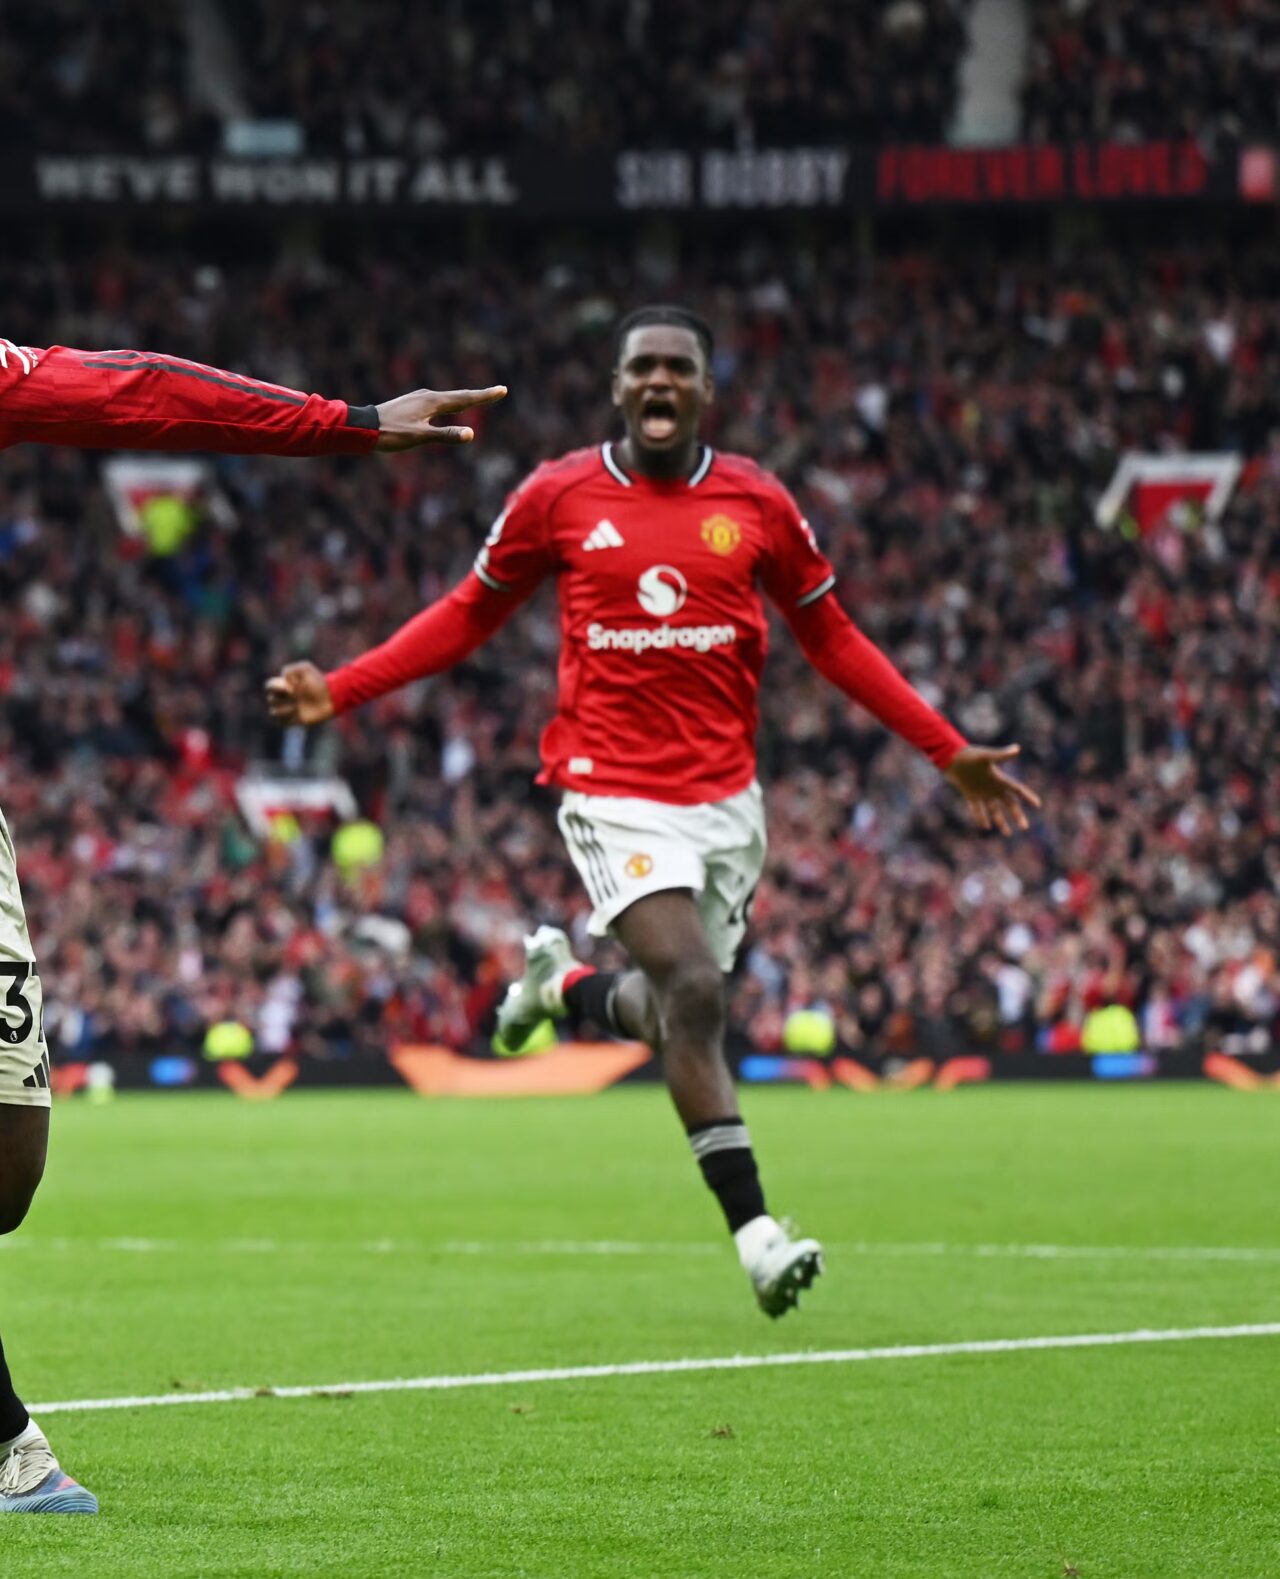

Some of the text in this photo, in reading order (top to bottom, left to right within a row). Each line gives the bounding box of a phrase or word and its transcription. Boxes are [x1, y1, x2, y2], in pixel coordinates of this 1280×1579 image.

[211, 158, 338, 201] WON
[347, 158, 405, 200] IT
[410, 159, 518, 202] ALL
[586, 622, 736, 655] Snapdragon
